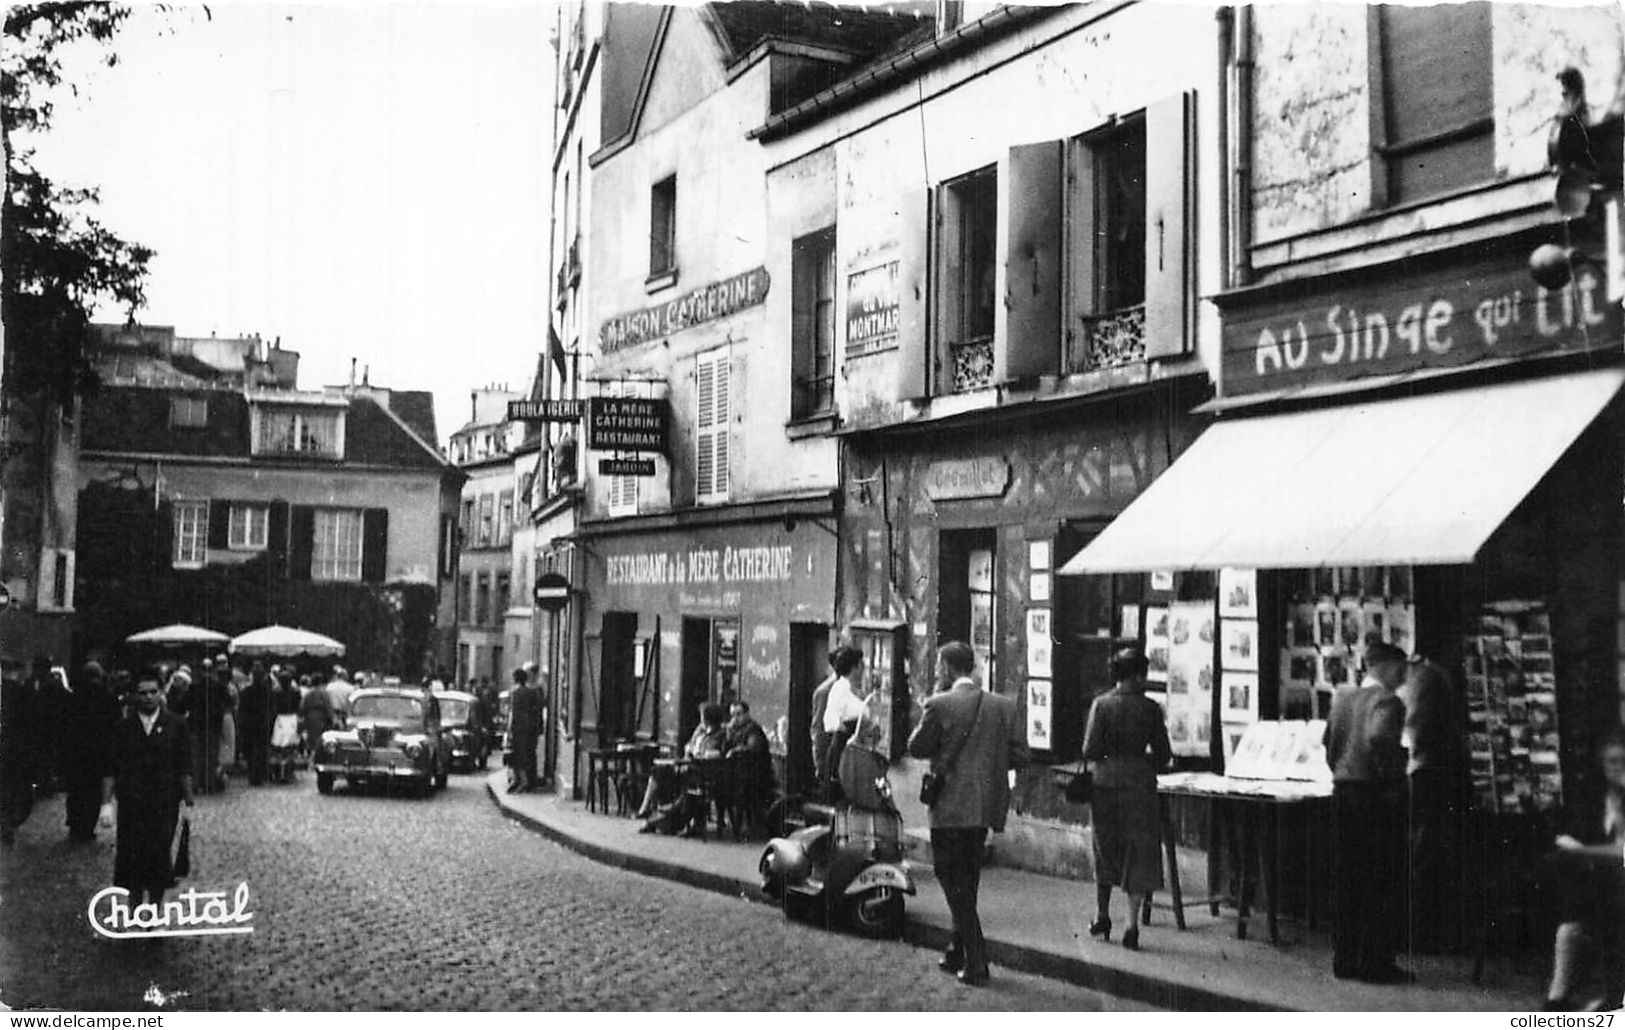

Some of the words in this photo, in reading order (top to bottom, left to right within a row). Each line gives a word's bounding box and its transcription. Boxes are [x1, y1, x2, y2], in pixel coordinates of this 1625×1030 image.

[605, 309, 660, 346] MAISON
[665, 274, 757, 331] CATHERINE
[1475, 290, 1523, 346] qui
[512, 400, 580, 417] BOULAGERIE
[602, 402, 618, 415] LA
[595, 416, 662, 429] CATHERINE
[595, 431, 662, 446] RESTAURANT
[607, 552, 668, 585] RESTAURANT
[723, 545, 792, 581] CATHERINE
